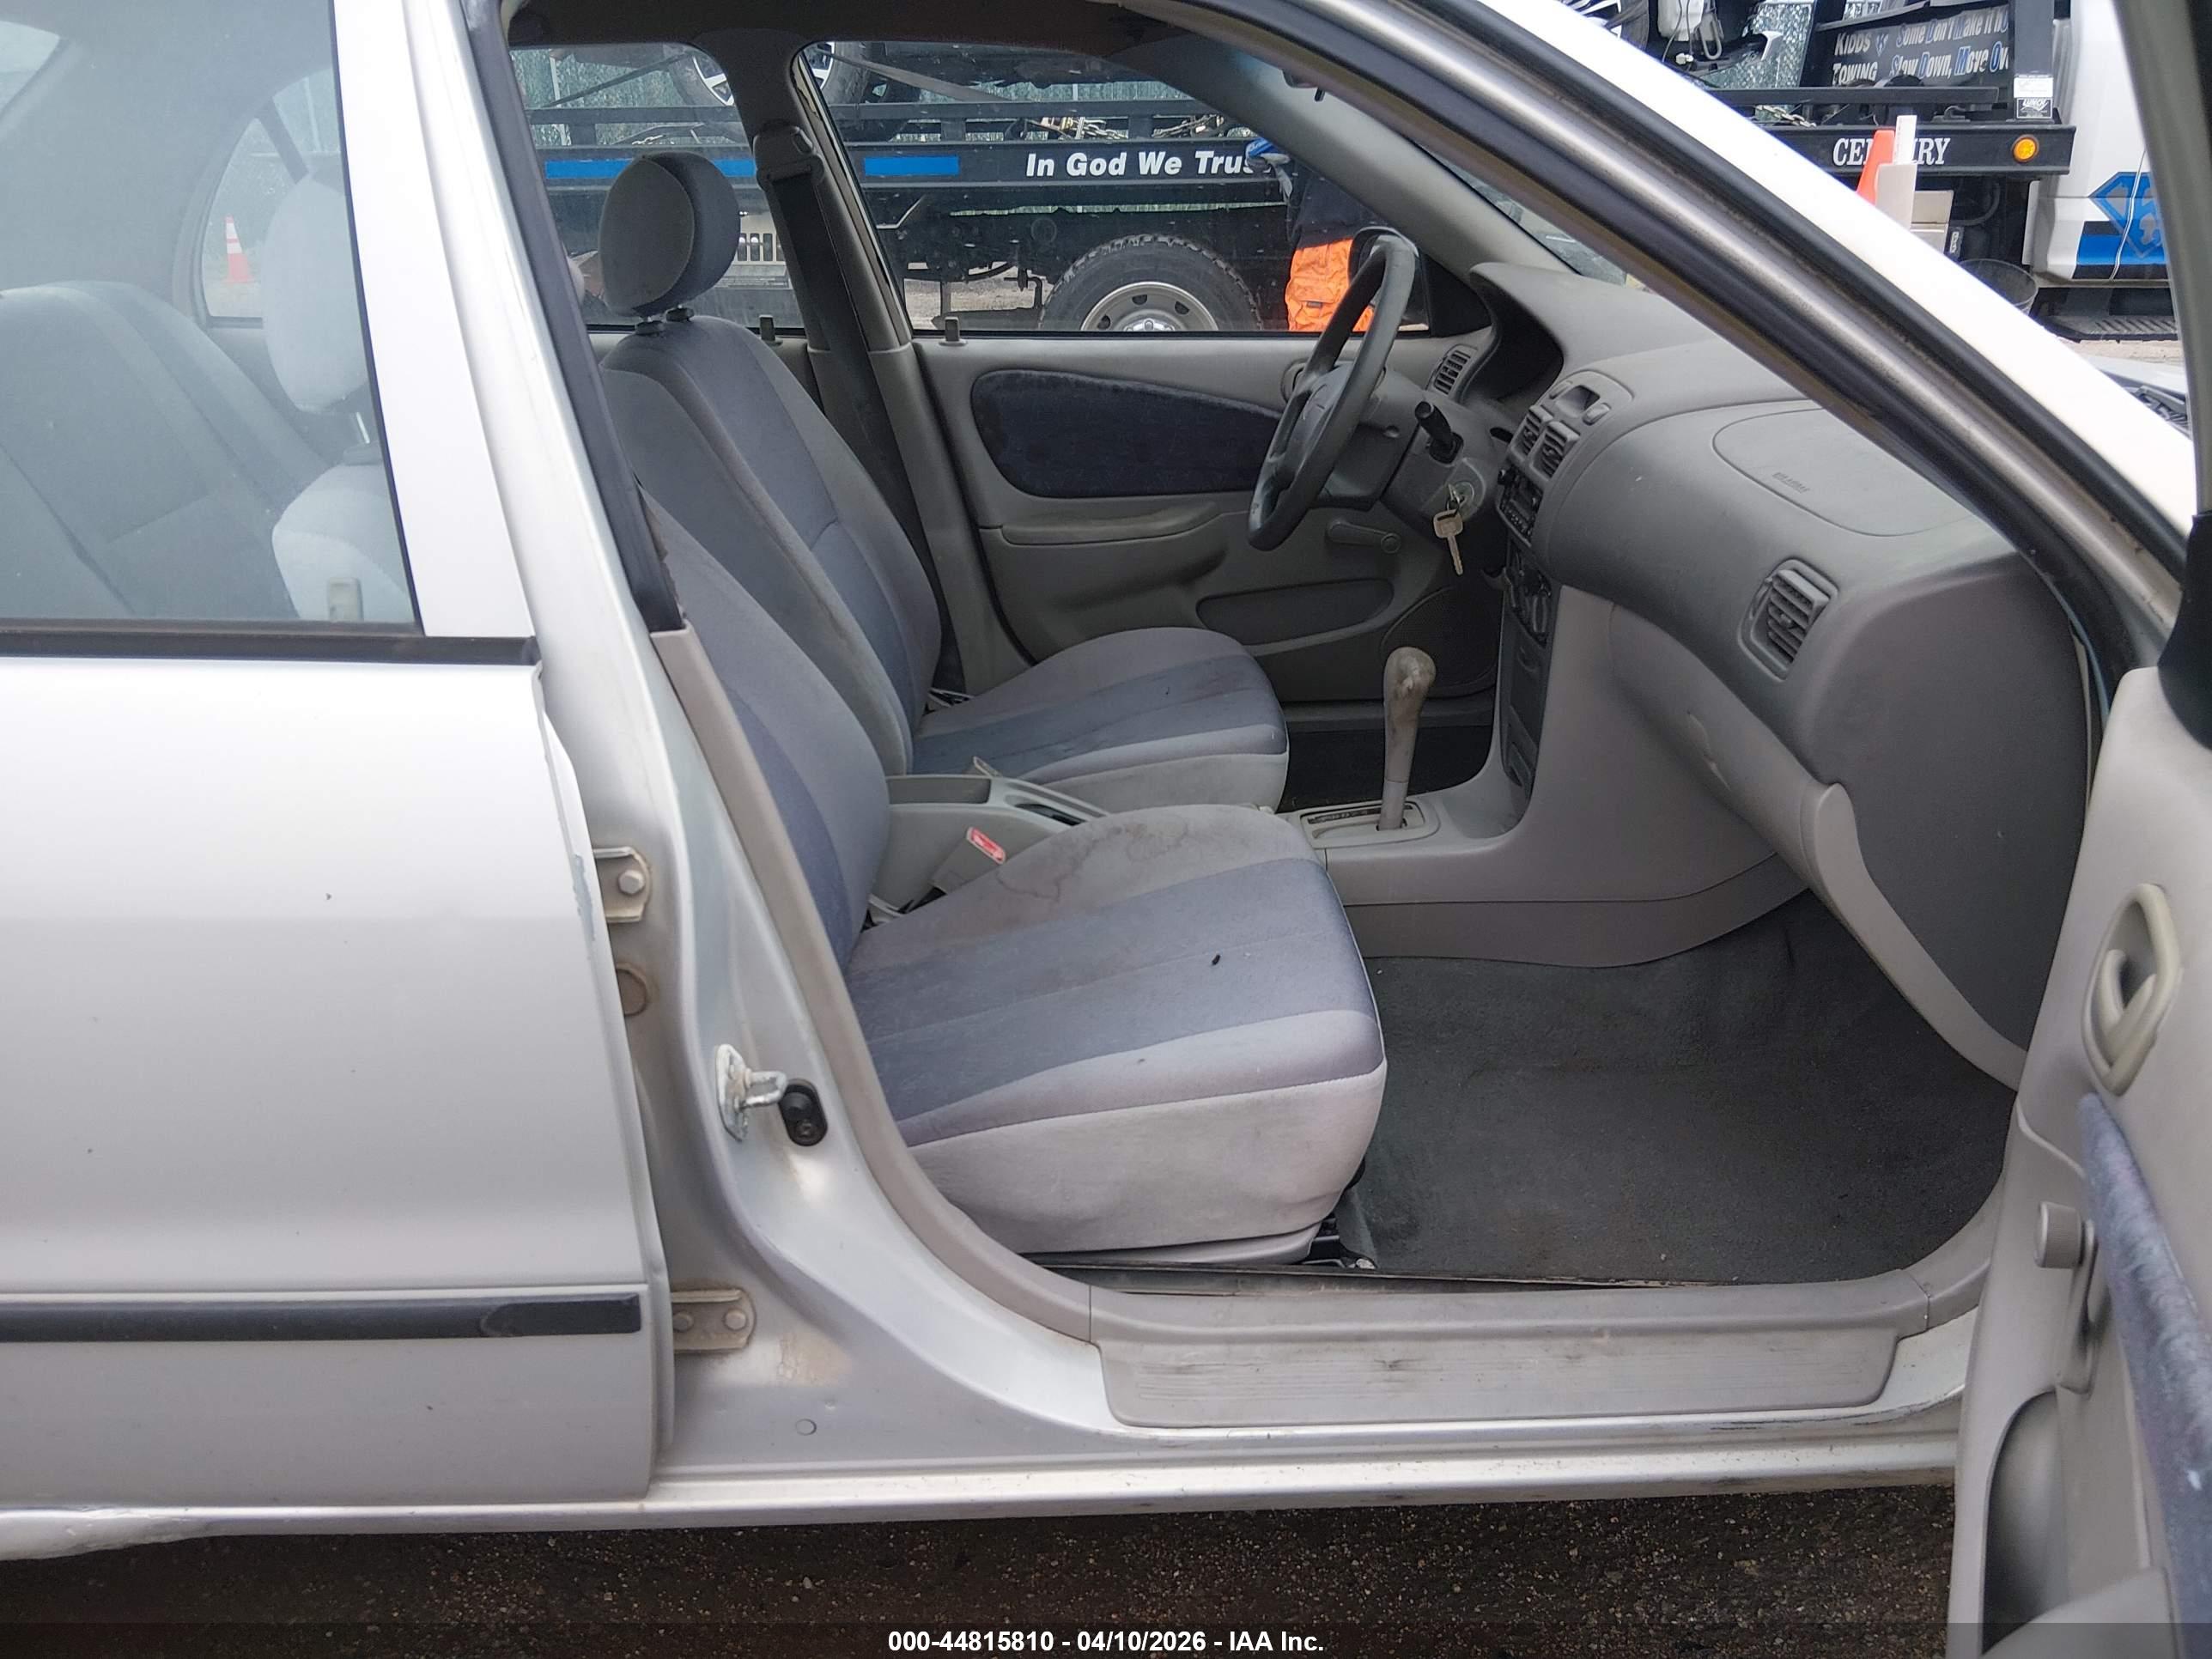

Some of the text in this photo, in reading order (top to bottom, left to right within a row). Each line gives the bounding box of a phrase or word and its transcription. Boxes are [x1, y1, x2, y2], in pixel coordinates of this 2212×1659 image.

[1895, 22, 1926, 47] Some
[1925, 18, 1954, 44] Don't
[1953, 13, 1983, 40] Make
[1832, 61, 1878, 86] TOWING
[1889, 54, 1919, 77] Slow
[1917, 52, 1952, 79] Down,
[1954, 46, 1989, 76] Move
[1025, 153, 1054, 177] In
[1066, 152, 1127, 177] God
[1138, 151, 1182, 175] We
[1832, 137, 1951, 166] CERY
